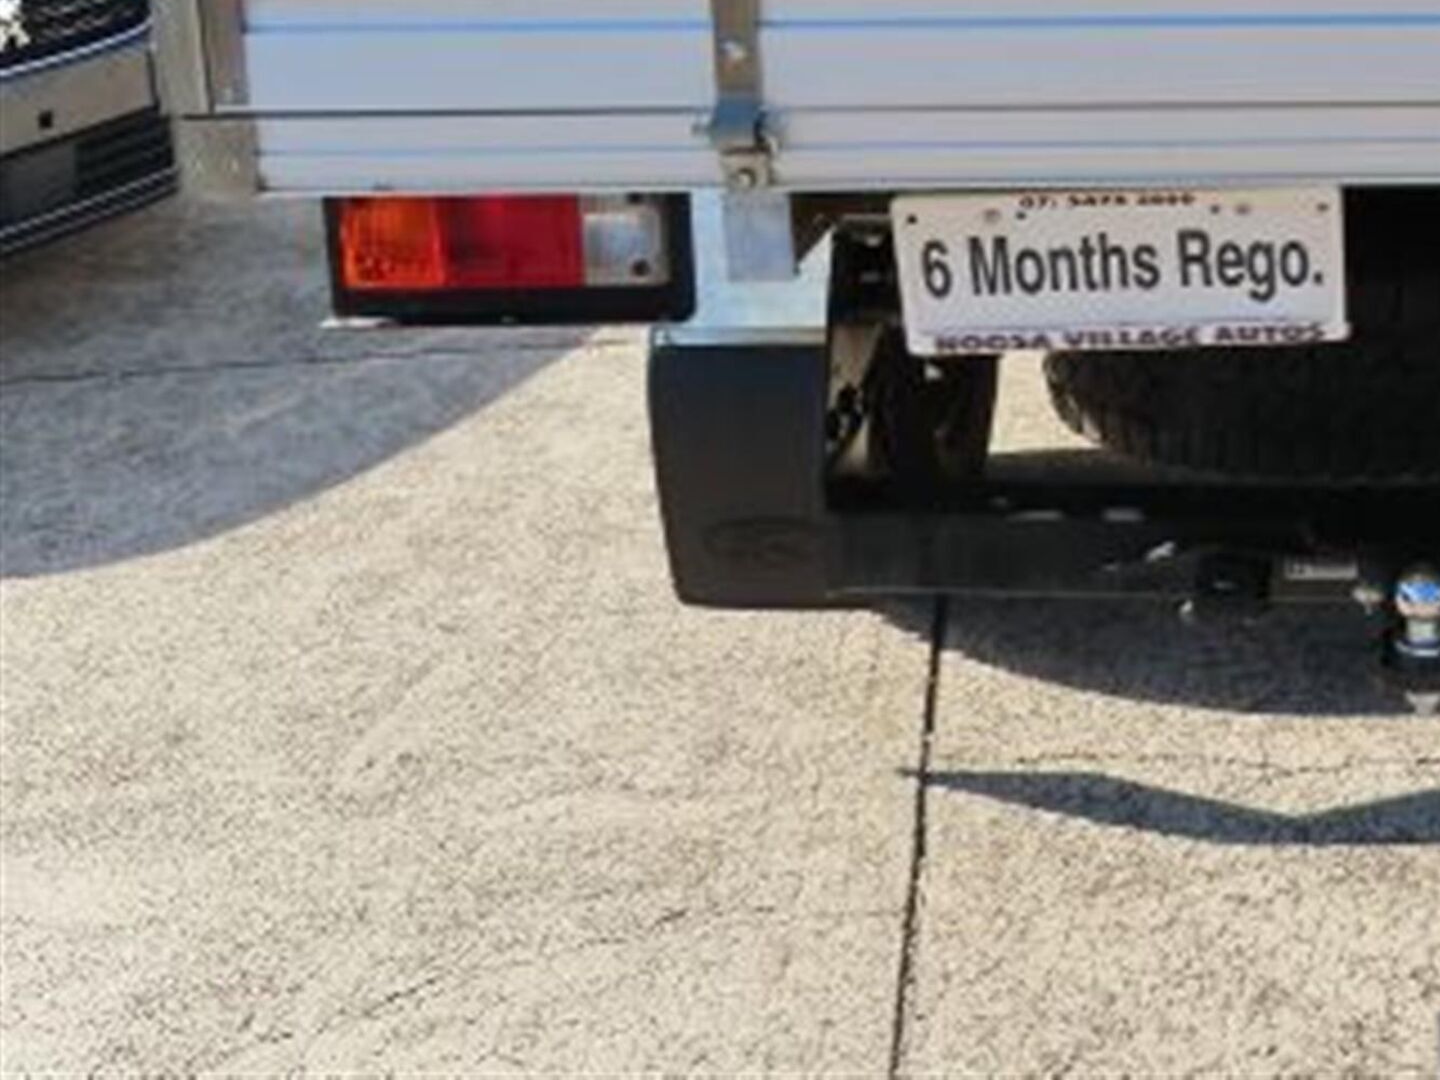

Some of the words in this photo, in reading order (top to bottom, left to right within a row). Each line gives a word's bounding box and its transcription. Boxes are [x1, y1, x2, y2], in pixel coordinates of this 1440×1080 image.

[921, 240, 952, 298] 6
[968, 232, 1160, 297] Months
[1177, 229, 1324, 302] Rego.
[935, 333, 1052, 351] NOOSA
[1063, 325, 1197, 347] VILLAGE
[1214, 322, 1326, 342] AUTOS
